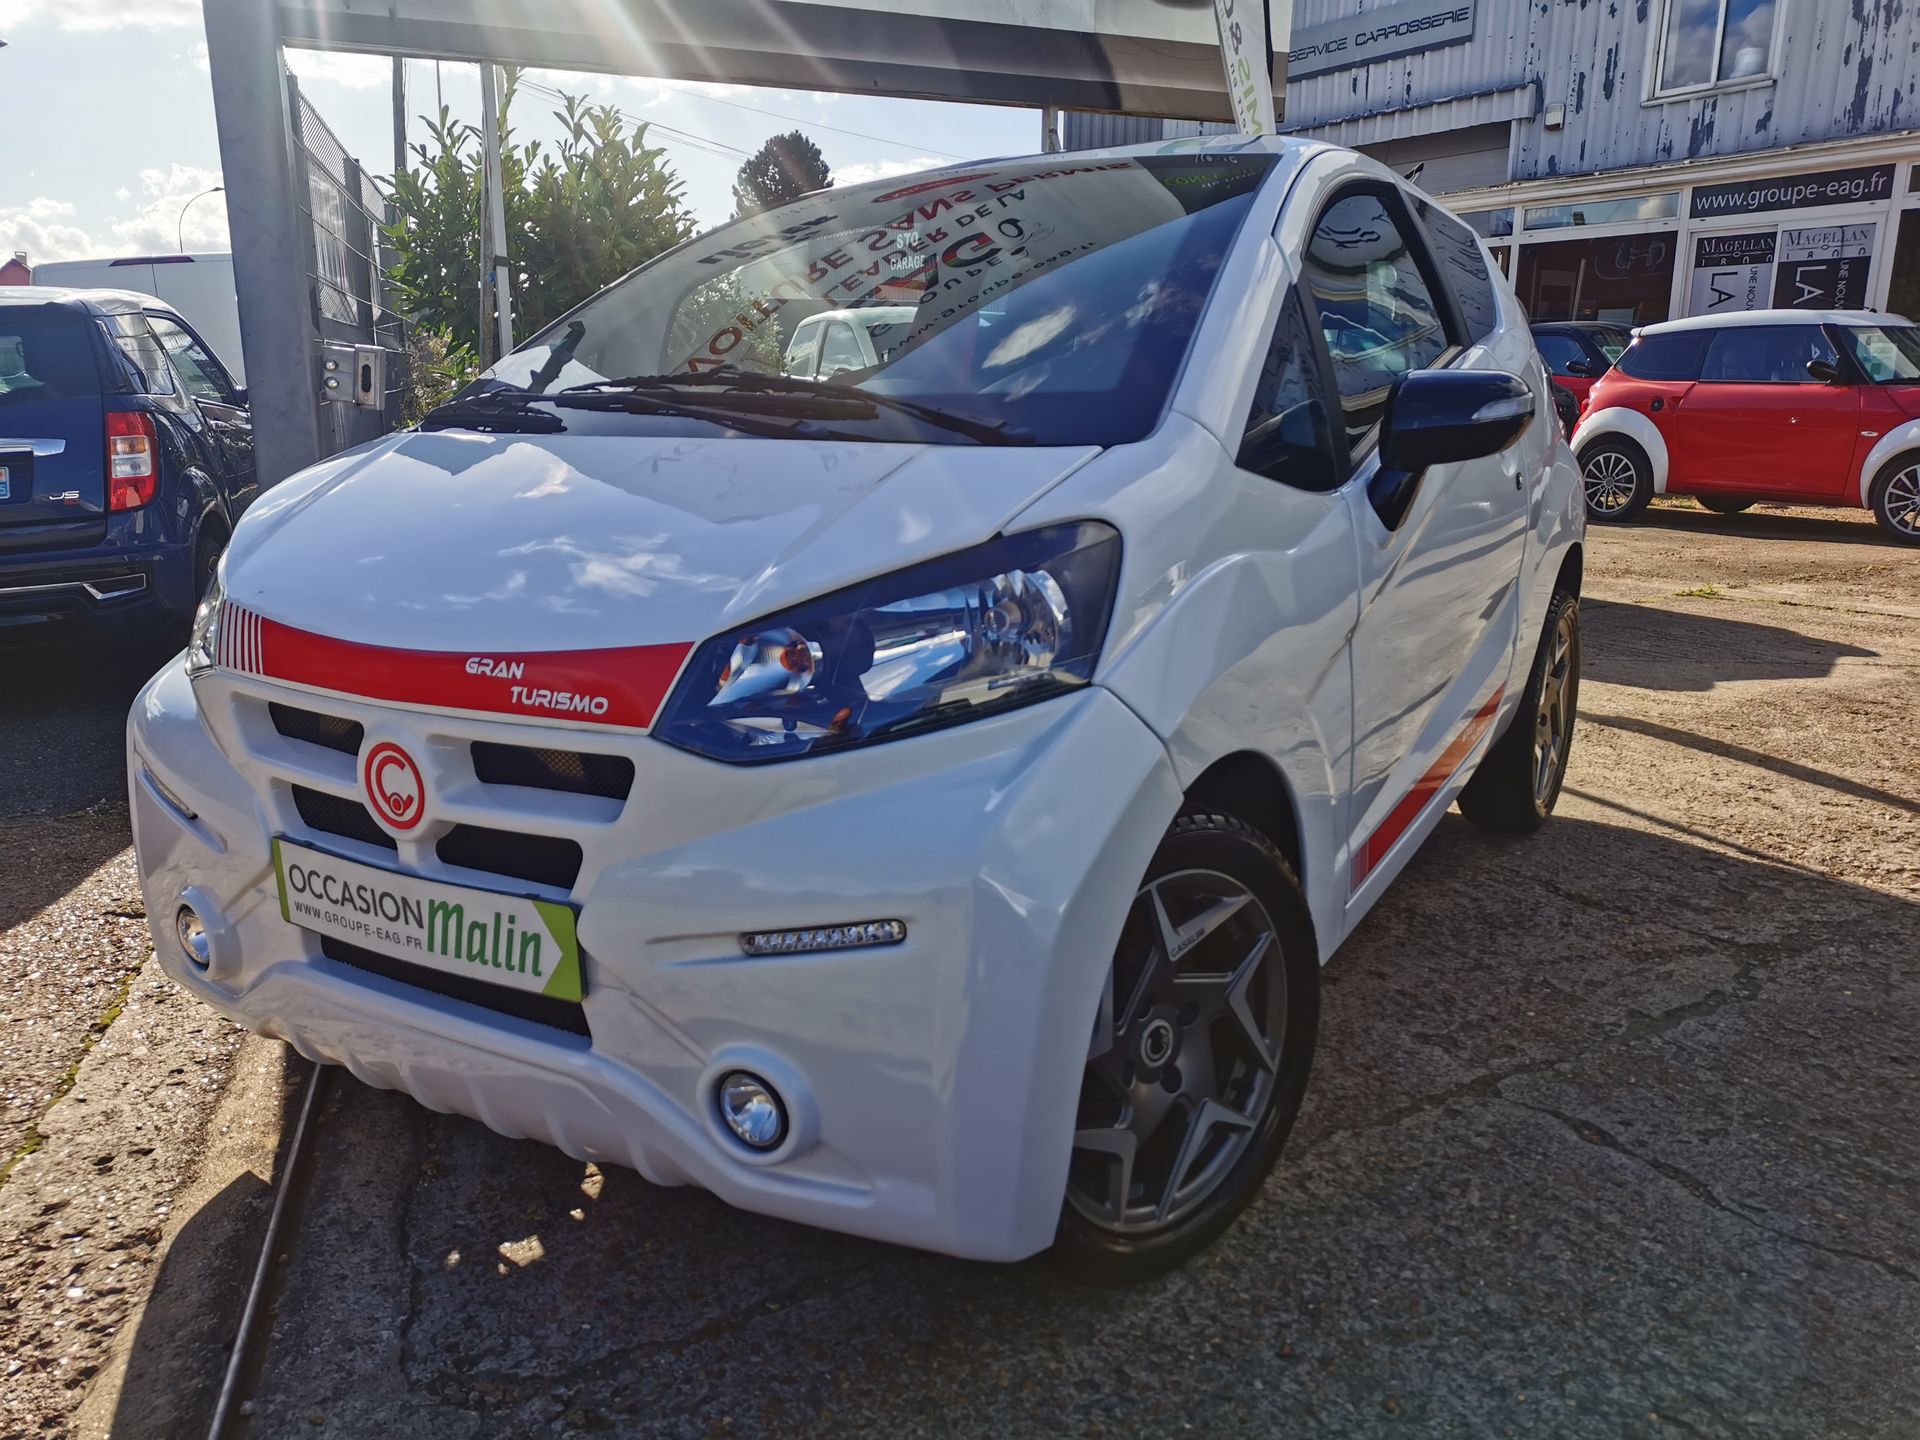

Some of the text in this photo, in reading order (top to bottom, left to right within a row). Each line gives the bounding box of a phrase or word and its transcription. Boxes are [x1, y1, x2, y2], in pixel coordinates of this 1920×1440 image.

[1288, 6, 1470, 63] SERVICE CARROSSERIE
[1696, 171, 1888, 210] www.groupe-eag.fr
[1701, 237, 1775, 255] MAGELLAN
[1785, 228, 1870, 248] MAGELLAN
[890, 254, 926, 271] GARAGE
[1708, 271, 1738, 308] LA
[1793, 265, 1828, 305] LA
[465, 656, 525, 680] GRAN
[510, 686, 609, 716] TURISMO
[288, 863, 425, 930] OCCASION
[293, 900, 423, 951] WWW.GROUPE-EAG.FR
